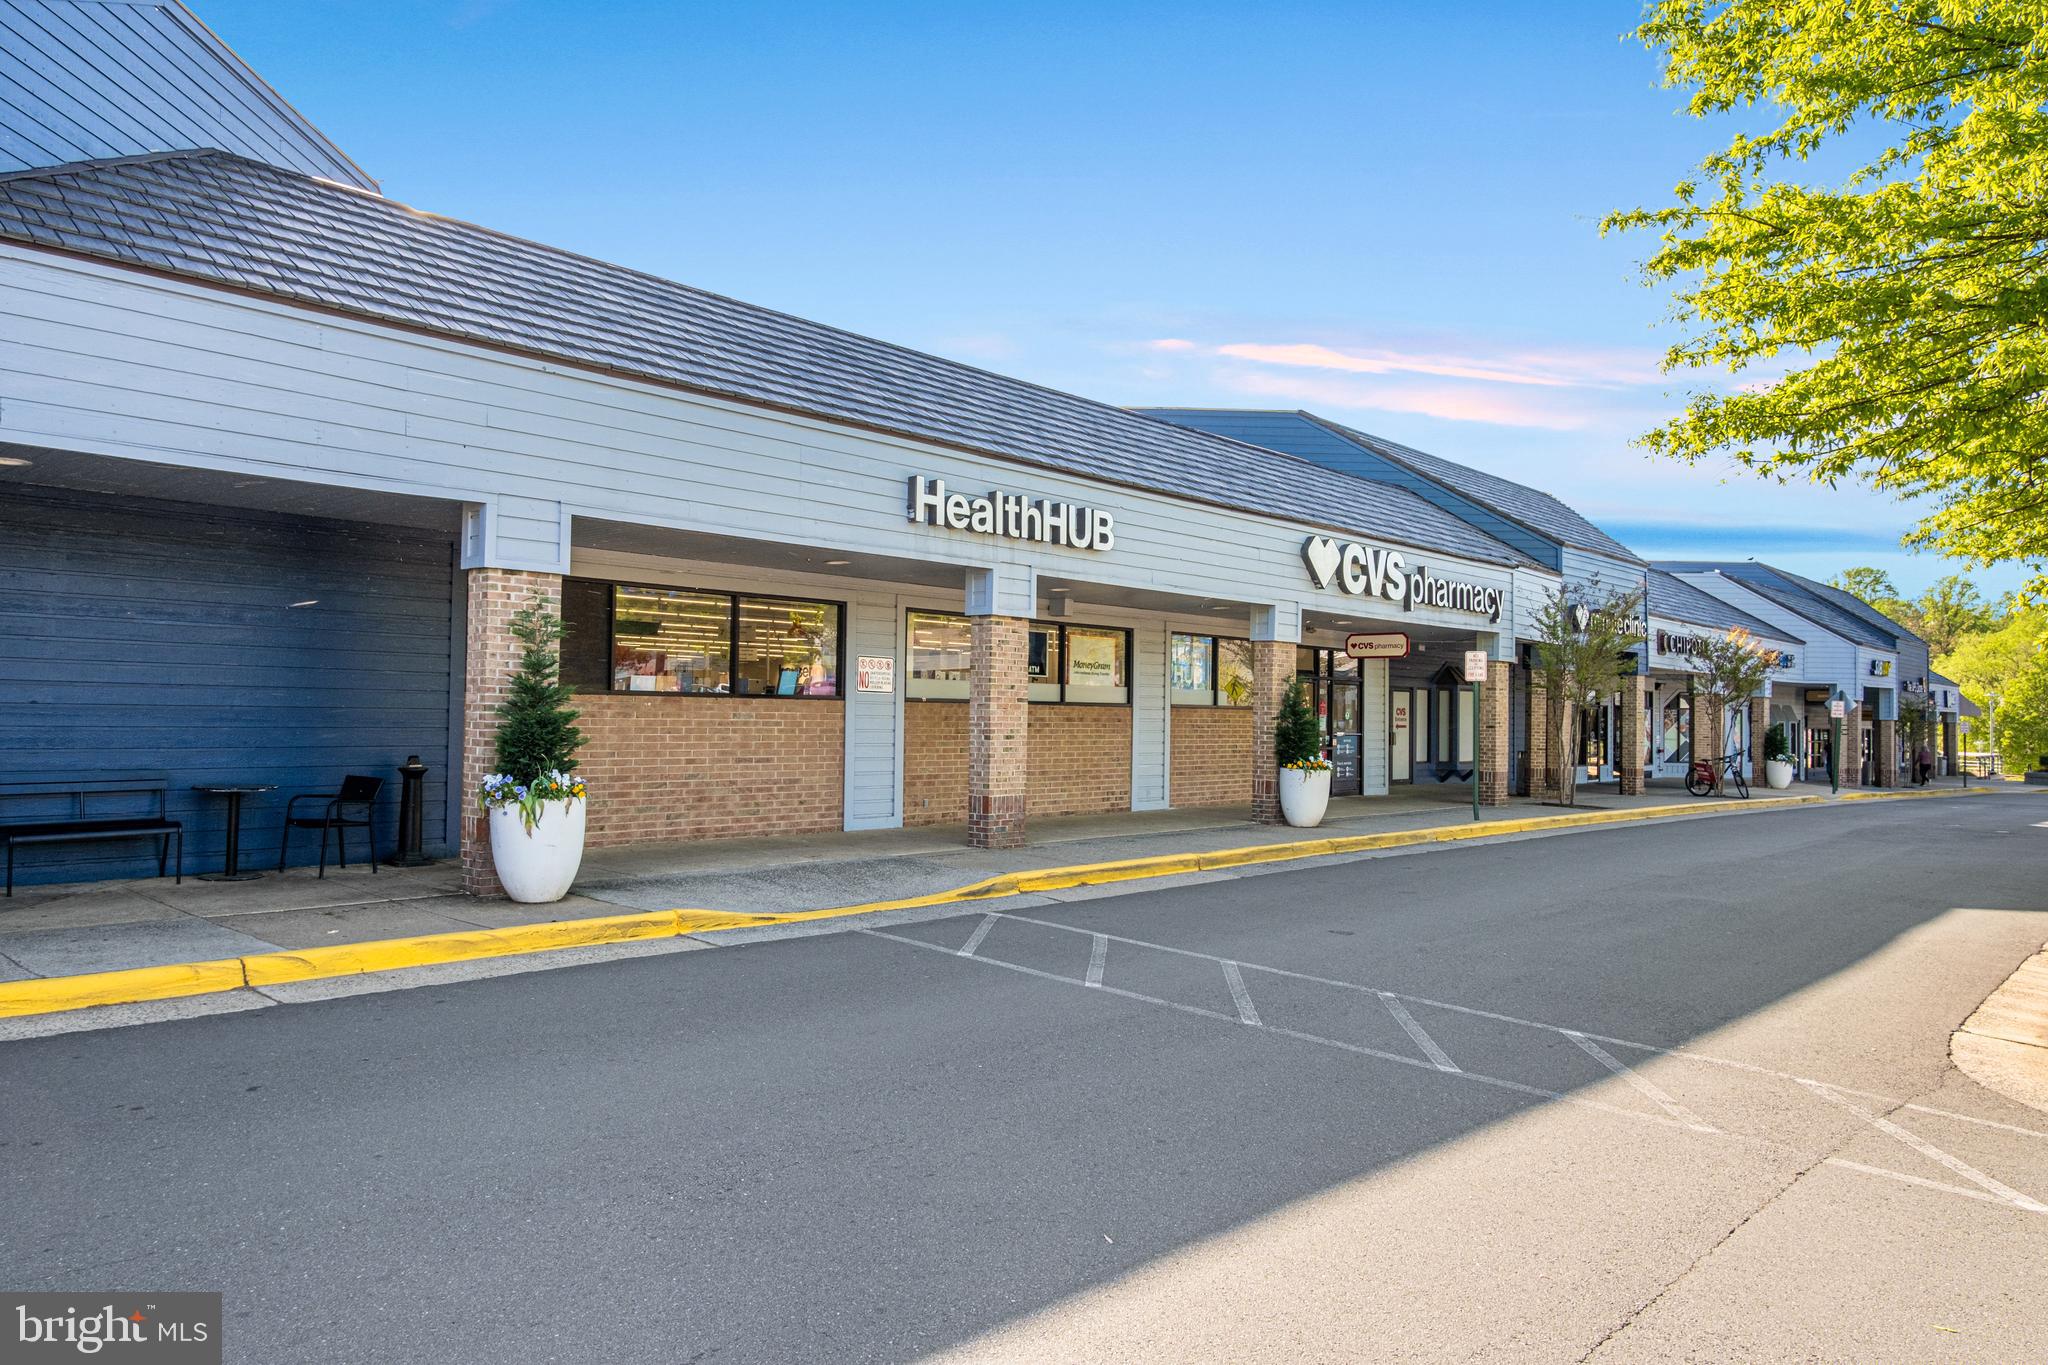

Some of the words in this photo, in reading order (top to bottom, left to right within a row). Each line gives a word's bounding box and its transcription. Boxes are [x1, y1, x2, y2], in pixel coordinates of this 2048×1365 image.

[909, 475, 1115, 551] HealthHUB
[1338, 543, 1406, 601] CVS
[1405, 566, 1505, 624] pharmacy
[1358, 642, 1374, 650] CVS
[1073, 660, 1111, 671] MoneyGram
[859, 671, 870, 688] NO
[1396, 707, 1407, 716] CVS
